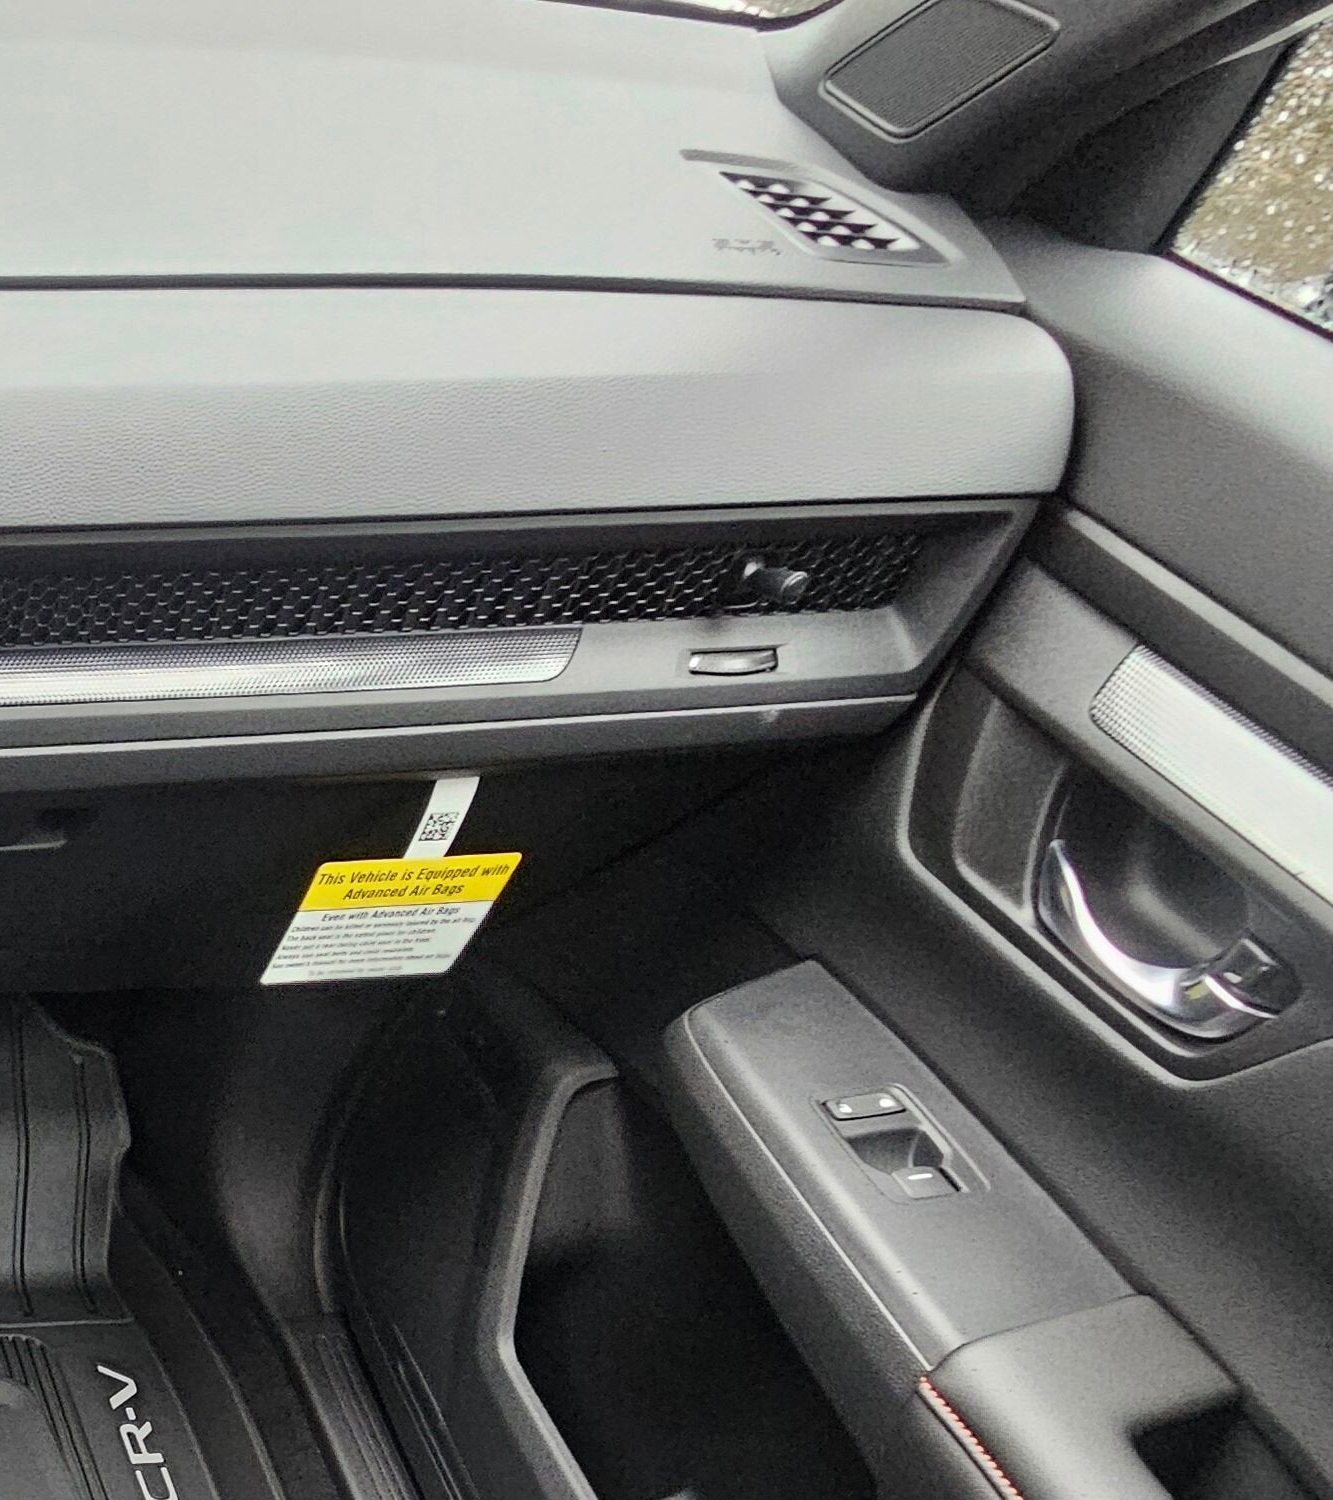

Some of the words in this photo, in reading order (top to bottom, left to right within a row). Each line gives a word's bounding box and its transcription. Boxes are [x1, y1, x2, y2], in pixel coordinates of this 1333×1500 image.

[317, 872, 346, 886] This
[349, 869, 398, 884] Vehicle
[400, 868, 414, 881] is
[416, 865, 480, 881] Equipped
[481, 864, 510, 876] with
[343, 885, 409, 900] Advanced
[409, 885, 432, 896] Air
[432, 884, 465, 896] Bags
[348, 911, 369, 920] with
[370, 908, 419, 919] Advanced
[420, 907, 435, 916] Air
[436, 906, 461, 916] Bags
